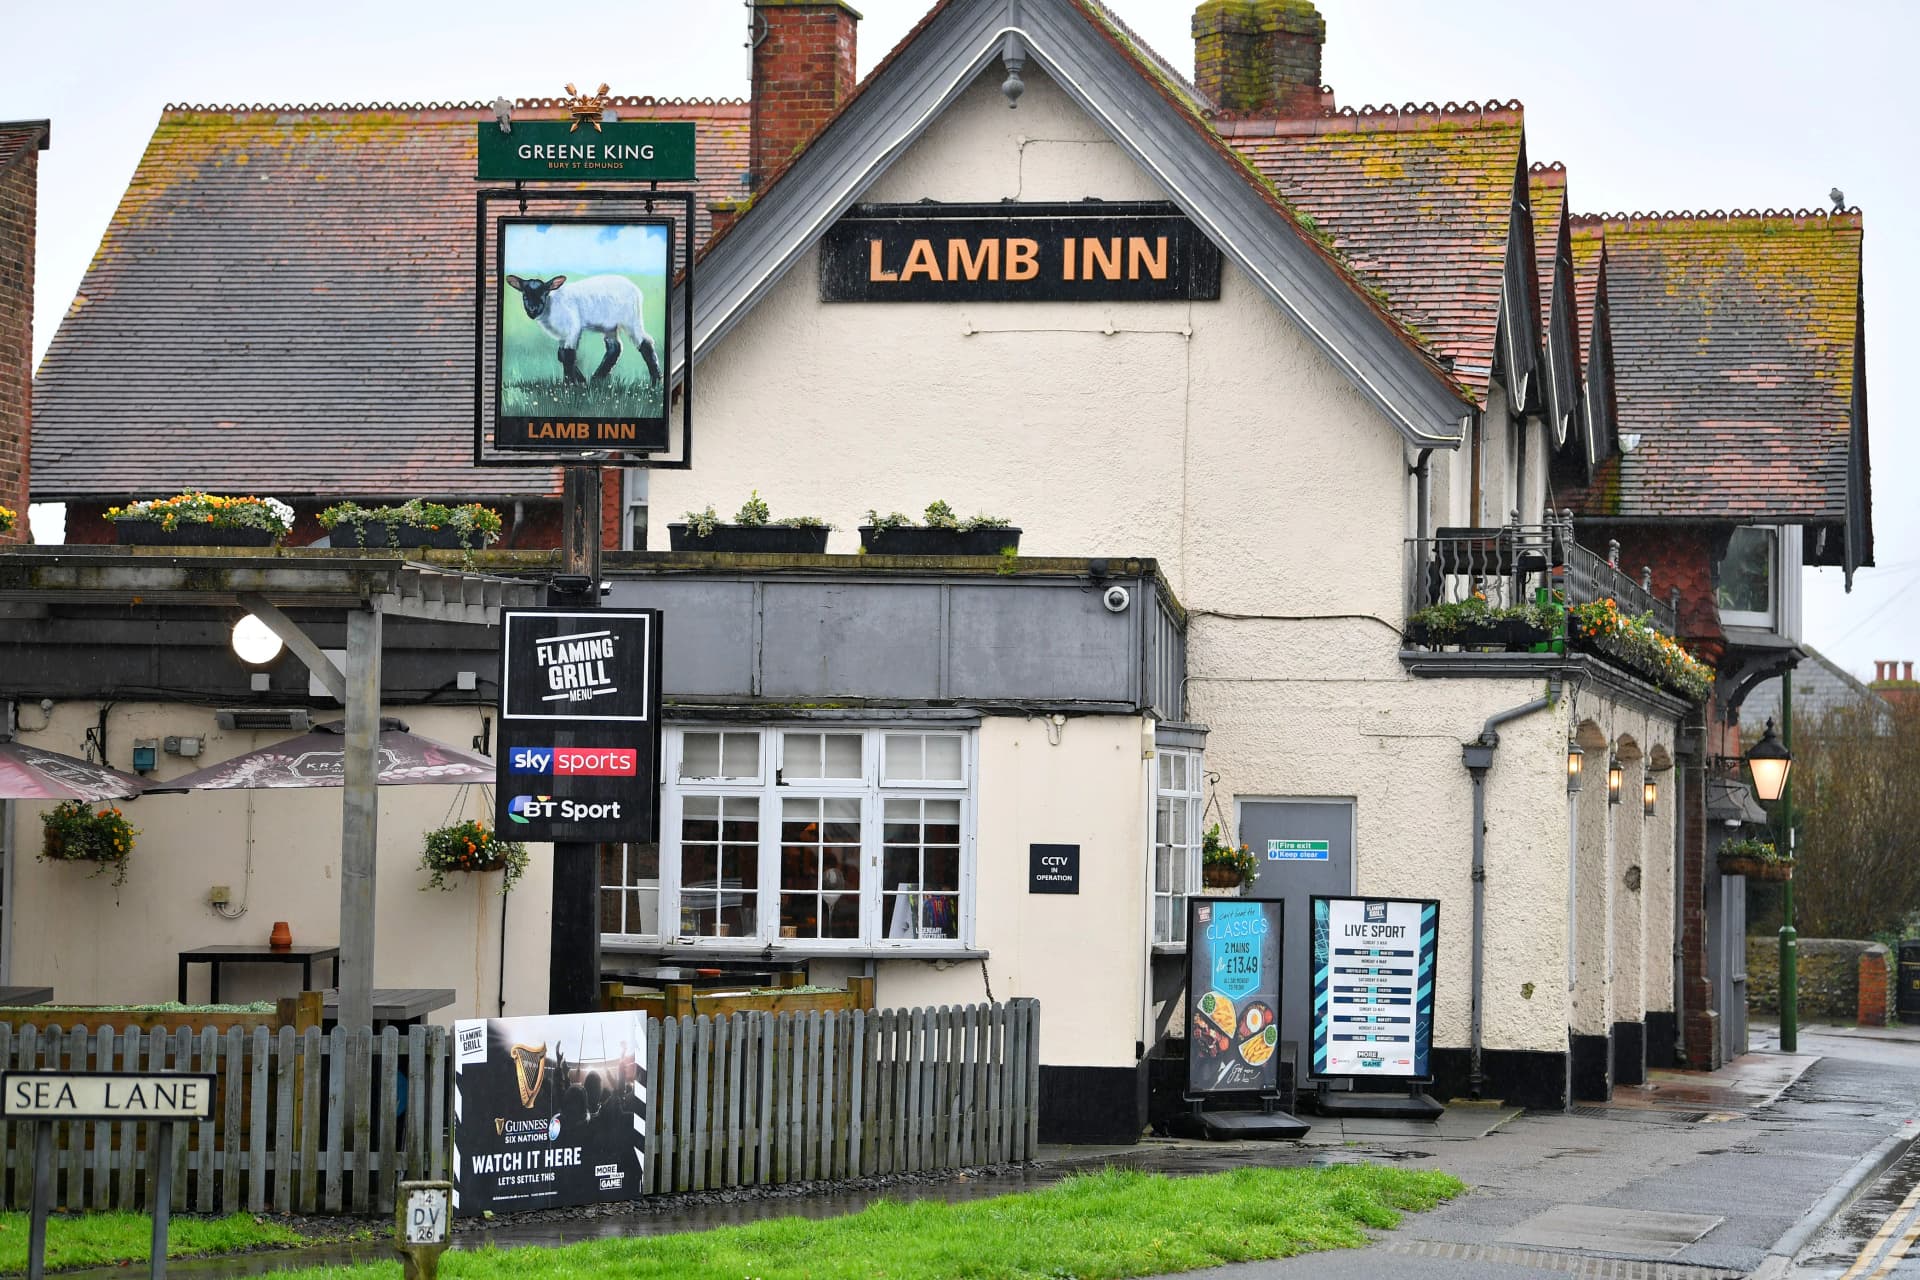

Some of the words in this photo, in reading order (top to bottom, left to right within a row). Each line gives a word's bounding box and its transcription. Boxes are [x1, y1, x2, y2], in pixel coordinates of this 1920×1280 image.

[518, 144, 596, 160] GREENE
[604, 144, 655, 160] KING
[869, 237, 1040, 282] LAMB
[1062, 236, 1168, 281] INN
[527, 422, 590, 439] LAMB
[597, 423, 636, 440] INN
[536, 638, 614, 666] FLAMING
[548, 660, 611, 690] GRILL
[569, 688, 593, 702] MENU
[514, 749, 551, 773] sky
[558, 752, 631, 773] sports
[523, 801, 558, 818] BT
[561, 800, 621, 822] Sport
[1041, 856, 1068, 866] CCTV
[1206, 918, 1268, 940] CLASSICS
[1344, 924, 1368, 937] LIVE
[1371, 925, 1407, 939] SPORT
[1224, 942, 1230, 954] 2
[1231, 942, 1250, 954] MAINS
[1226, 956, 1258, 974] £13.49
[460, 1030, 482, 1042] FLAMING
[463, 1039, 481, 1052] GRILL
[16, 1081, 77, 1109] SEA
[104, 1082, 197, 1110] LANE
[505, 1119, 548, 1133] GUINNESS
[505, 1135, 516, 1144] SIX
[517, 1133, 548, 1143] NATIONS
[472, 1151, 522, 1175] WATCH
[527, 1150, 541, 1170] IT
[545, 1147, 582, 1168] HERE
[596, 1165, 617, 1175] MORE
[498, 1175, 516, 1186] LET'S
[516, 1174, 540, 1185] SETTLE
[541, 1172, 556, 1182] THIS
[601, 1179, 621, 1188] GAME
[418, 1228, 433, 1240] 26
